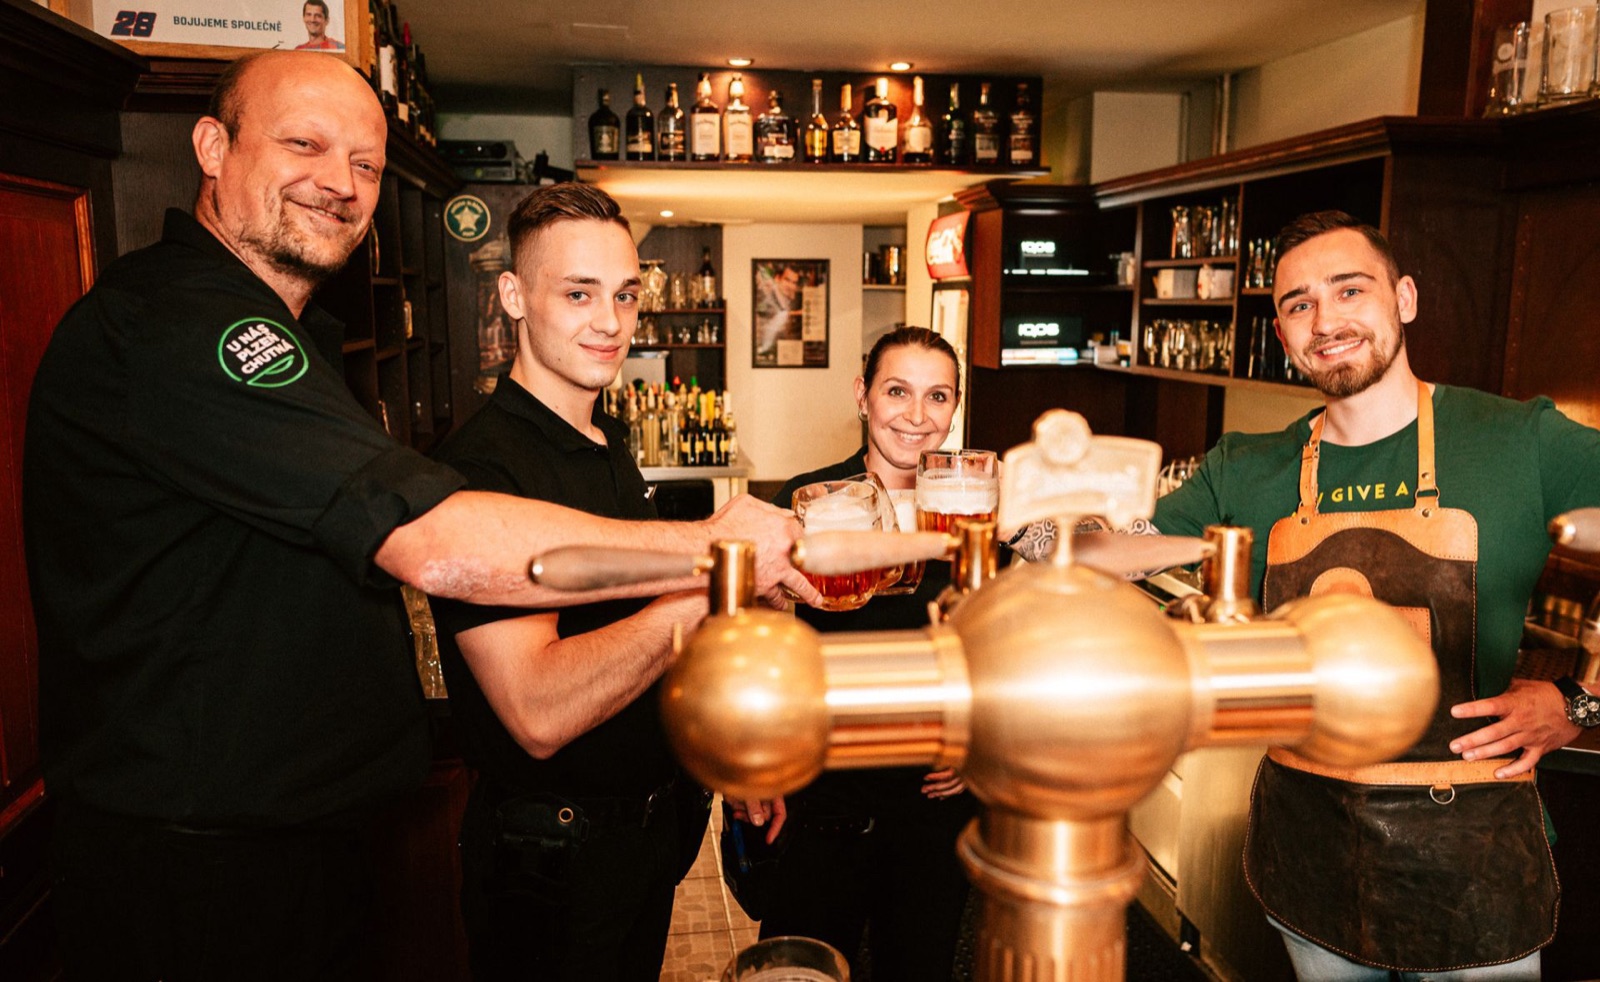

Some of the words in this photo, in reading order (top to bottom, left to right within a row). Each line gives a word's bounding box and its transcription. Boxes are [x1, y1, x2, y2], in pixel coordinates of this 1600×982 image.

[111, 10, 157, 37] 28
[173, 16, 229, 28] BOJUJEME
[1331, 483, 1386, 502] GIVE
[1395, 481, 1409, 497] A
